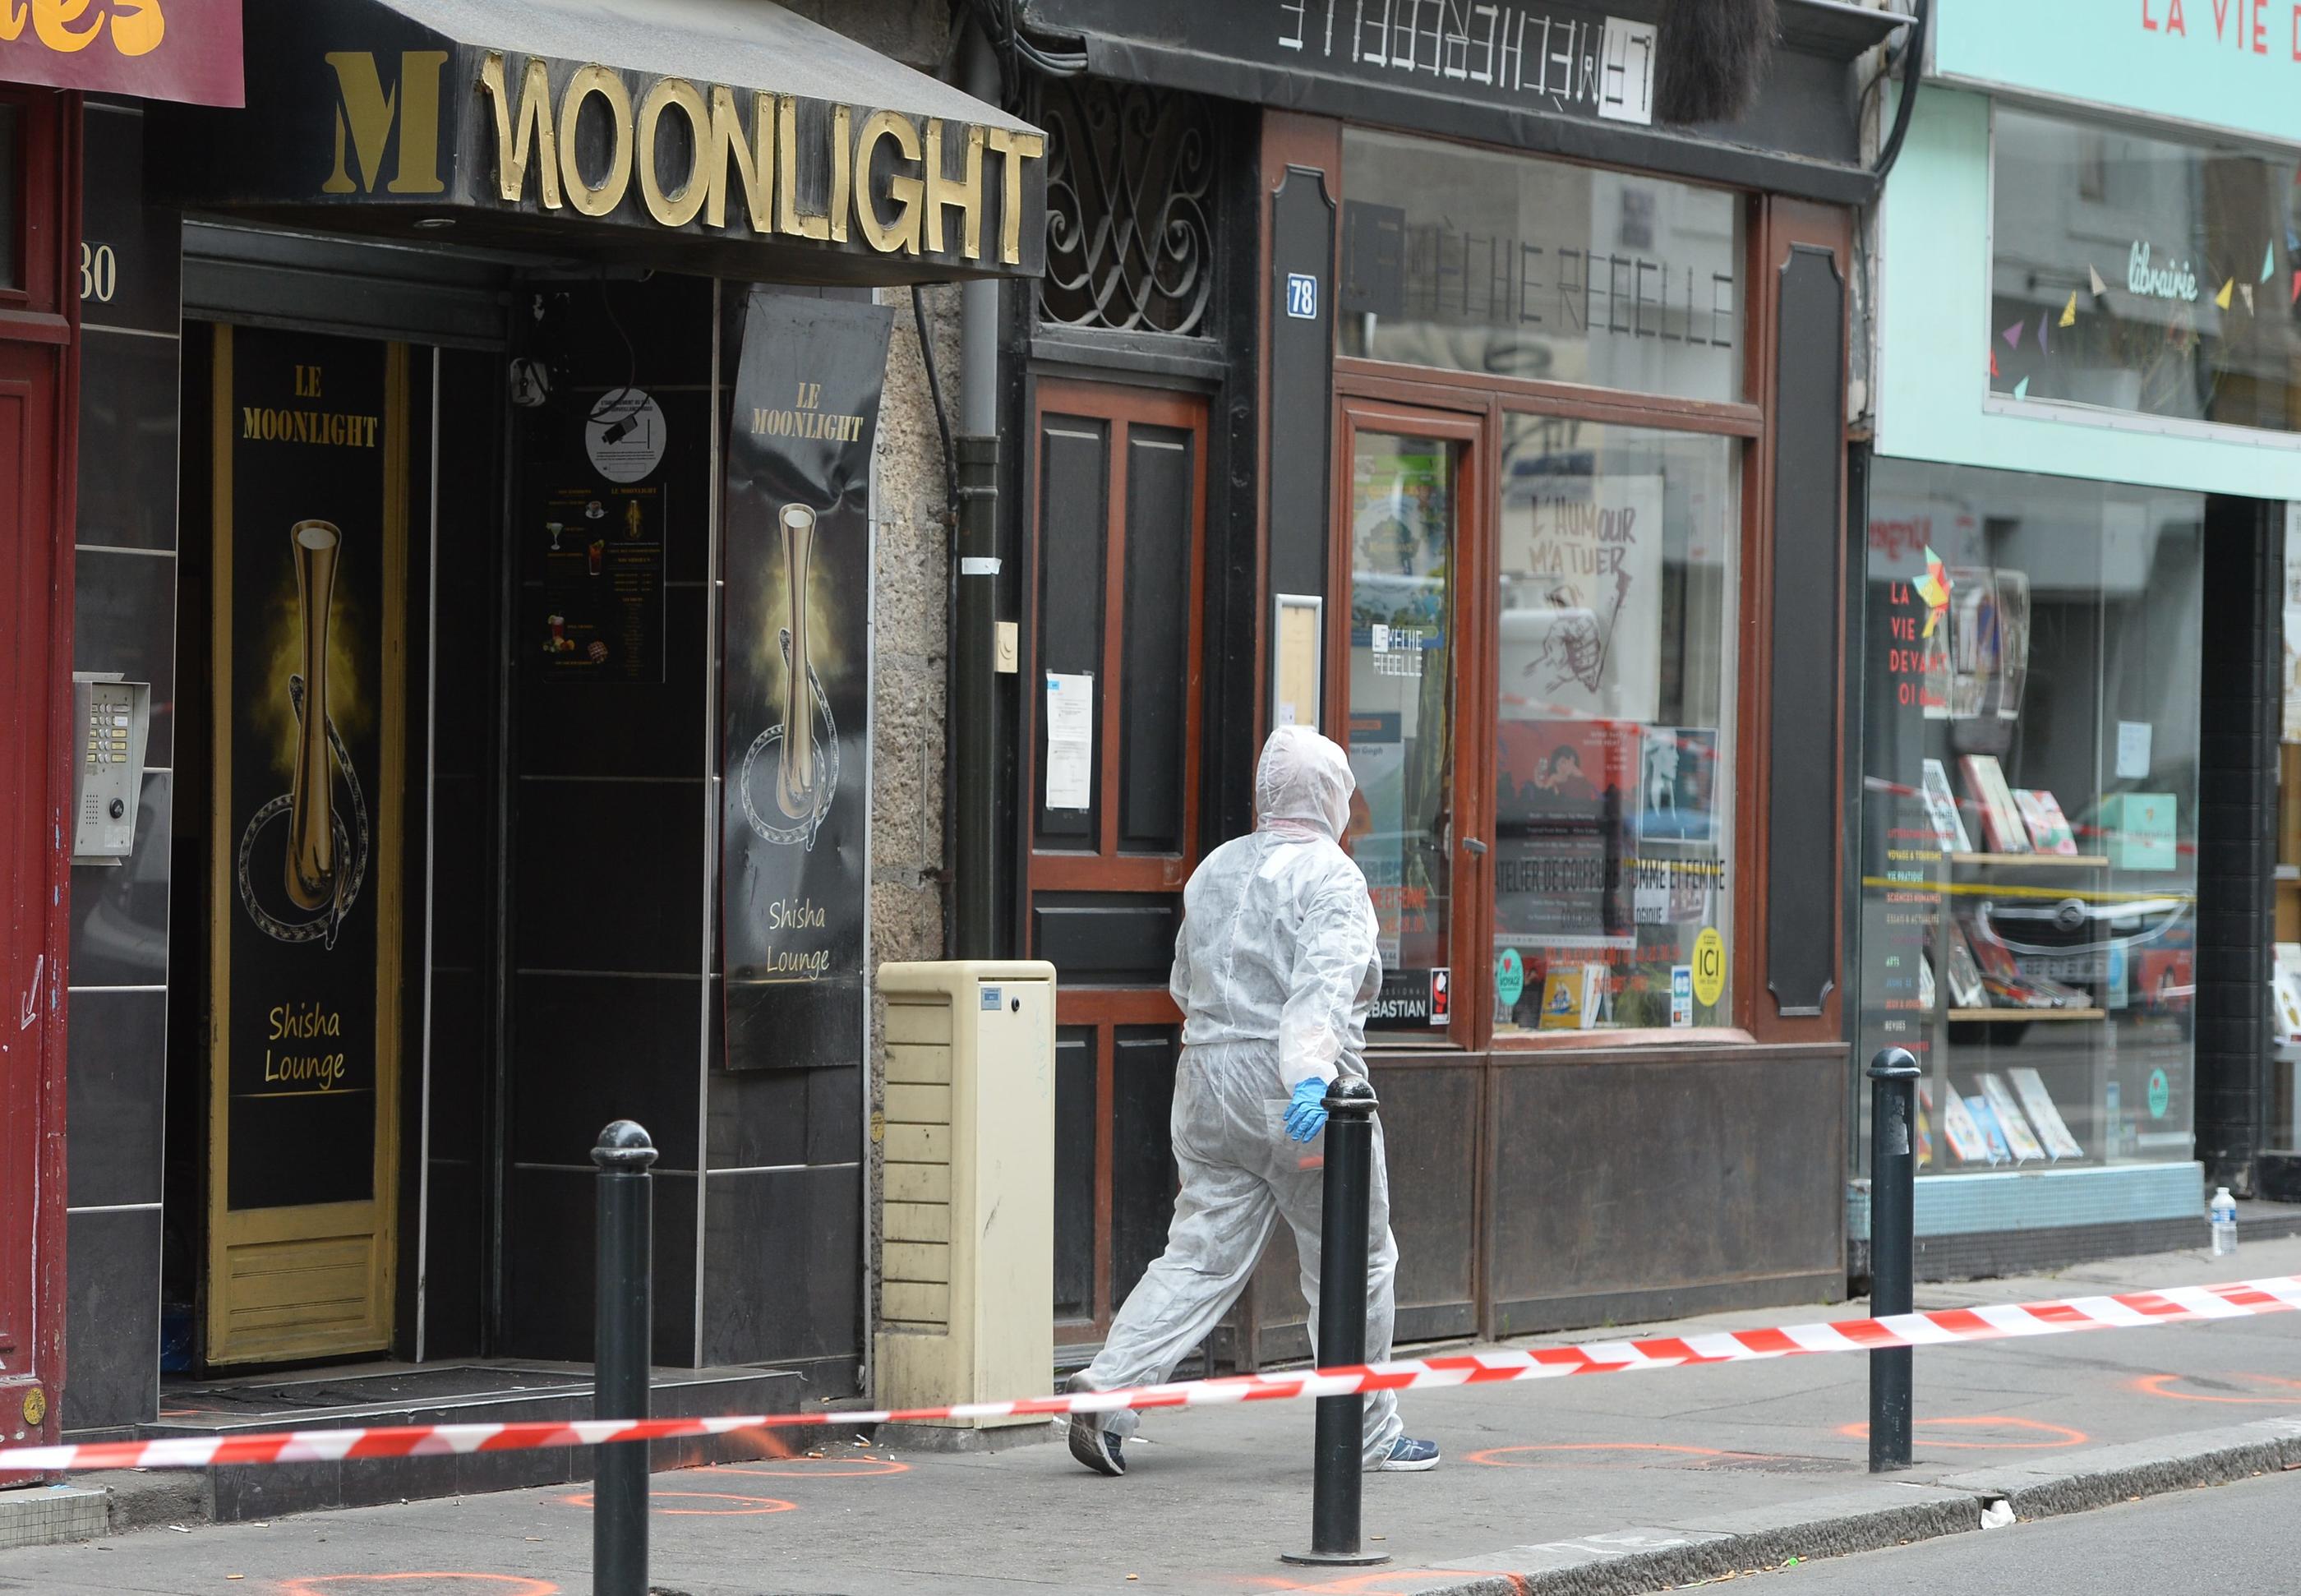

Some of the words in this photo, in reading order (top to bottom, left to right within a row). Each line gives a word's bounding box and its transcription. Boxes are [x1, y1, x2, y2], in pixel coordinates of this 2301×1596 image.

[322, 50, 449, 193] M
[482, 49, 1043, 265] MOONLIGHT
[2128, 241, 2198, 302] librairie
[1290, 280, 1313, 313] 78
[295, 365, 321, 397] LE
[795, 382, 821, 410] LE
[243, 407, 378, 448] MOONLIGHT
[751, 408, 865, 442] MOONLIGHT
[1530, 495, 1636, 544] L'HUMOUR
[1563, 542, 1626, 575] TUER
[1892, 582, 1910, 605] LA
[1892, 618, 1916, 641] VIE
[1890, 650, 1946, 674] DEVANT
[1670, 860, 1681, 889] ET
[1686, 860, 1725, 890] FEMME
[769, 898, 825, 929] Shisha
[767, 946, 830, 980] Lounge
[1699, 949, 1719, 976] ICI
[270, 1002, 339, 1040] Shisha
[1367, 999, 1425, 1018] BASTIAN
[265, 1049, 345, 1091] Lounge
